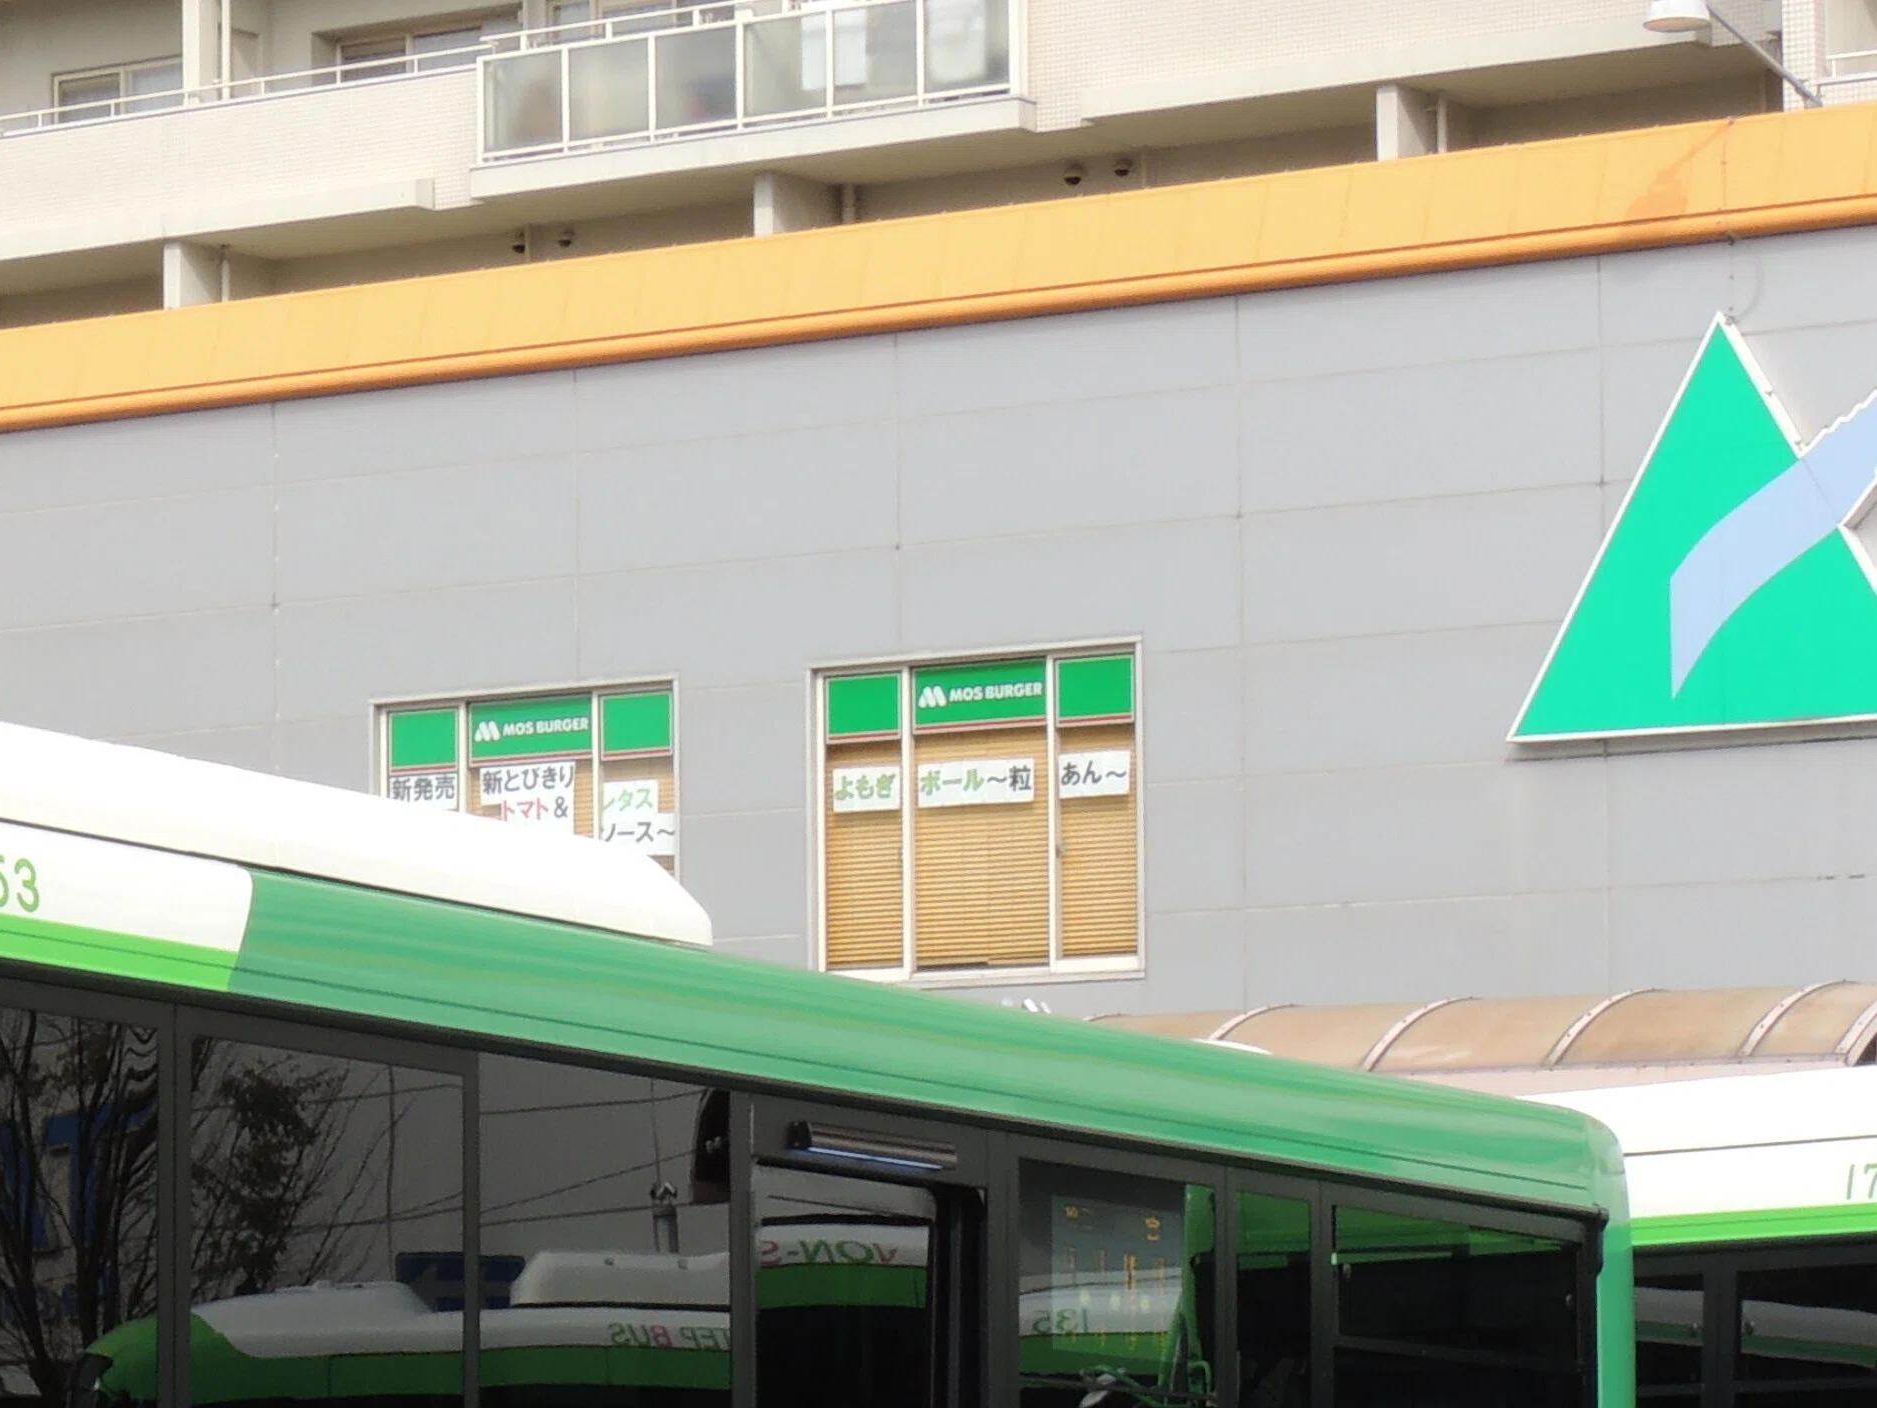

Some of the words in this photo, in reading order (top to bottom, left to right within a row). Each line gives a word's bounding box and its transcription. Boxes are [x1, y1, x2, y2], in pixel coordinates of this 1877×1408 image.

[949, 687, 983, 702] MOS
[984, 681, 1043, 700] BURGER
[502, 720, 534, 737] MOS
[535, 716, 589, 734] BURGER
[392, 775, 456, 802] 新発売
[482, 765, 574, 795] 新とびきり
[834, 772, 896, 801] よもぎ
